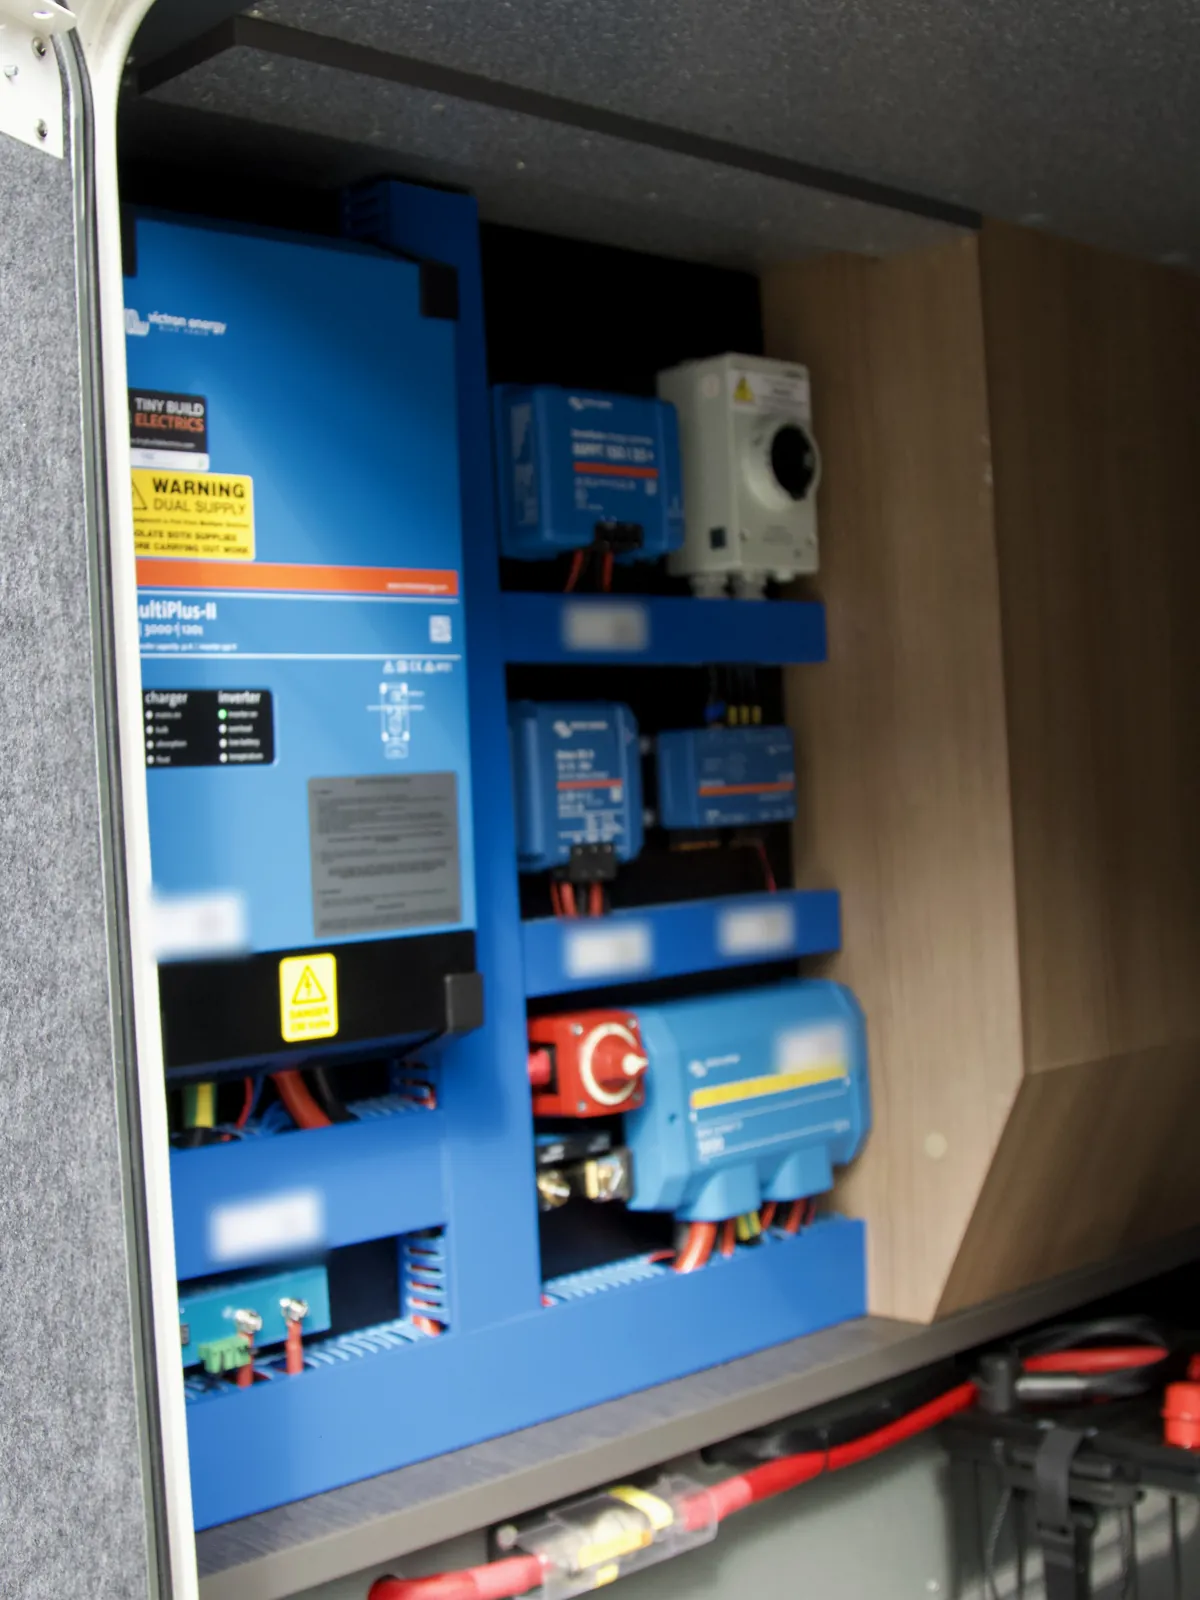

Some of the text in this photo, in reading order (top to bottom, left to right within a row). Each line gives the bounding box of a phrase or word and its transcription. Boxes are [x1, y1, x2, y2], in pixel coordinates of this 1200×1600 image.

[134, 397, 204, 418] TINY BUILD
[134, 413, 205, 432] ELECTRICS
[152, 477, 246, 499] WARNING
[153, 498, 246, 516] DUAL SUPPLY
[138, 600, 217, 621] ultiPlus-II
[145, 691, 188, 709] charger
[217, 690, 262, 705] inverter
